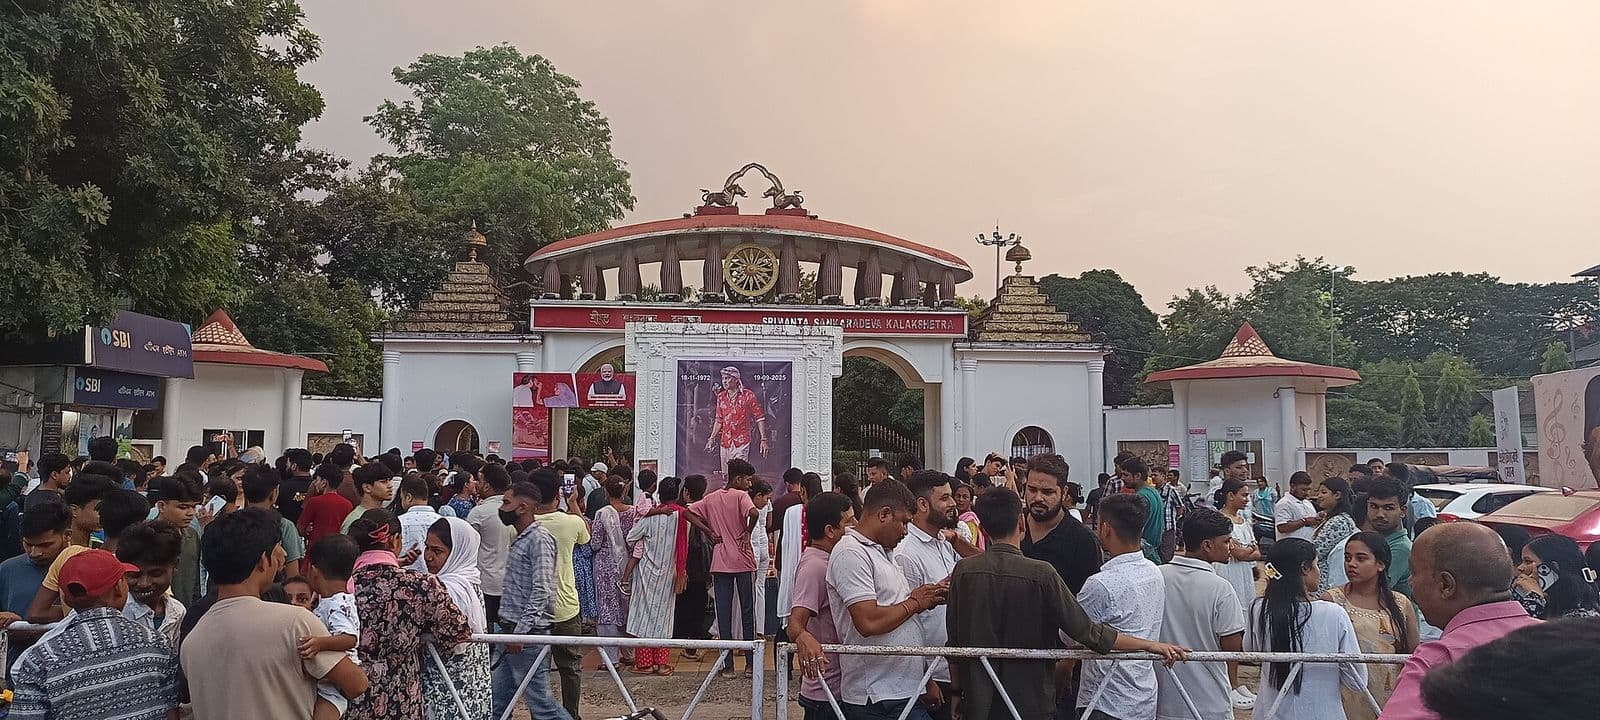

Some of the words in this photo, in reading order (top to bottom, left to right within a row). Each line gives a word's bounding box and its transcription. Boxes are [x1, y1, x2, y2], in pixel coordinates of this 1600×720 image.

[762, 317, 809, 325] SRIMANTA
[813, 318, 882, 329] SANKARADEVA
[886, 319, 954, 330] KALAKSHETRA
[112, 329, 131, 348] SBI
[176, 349, 187, 357] ATM
[85, 377, 101, 393] SBI
